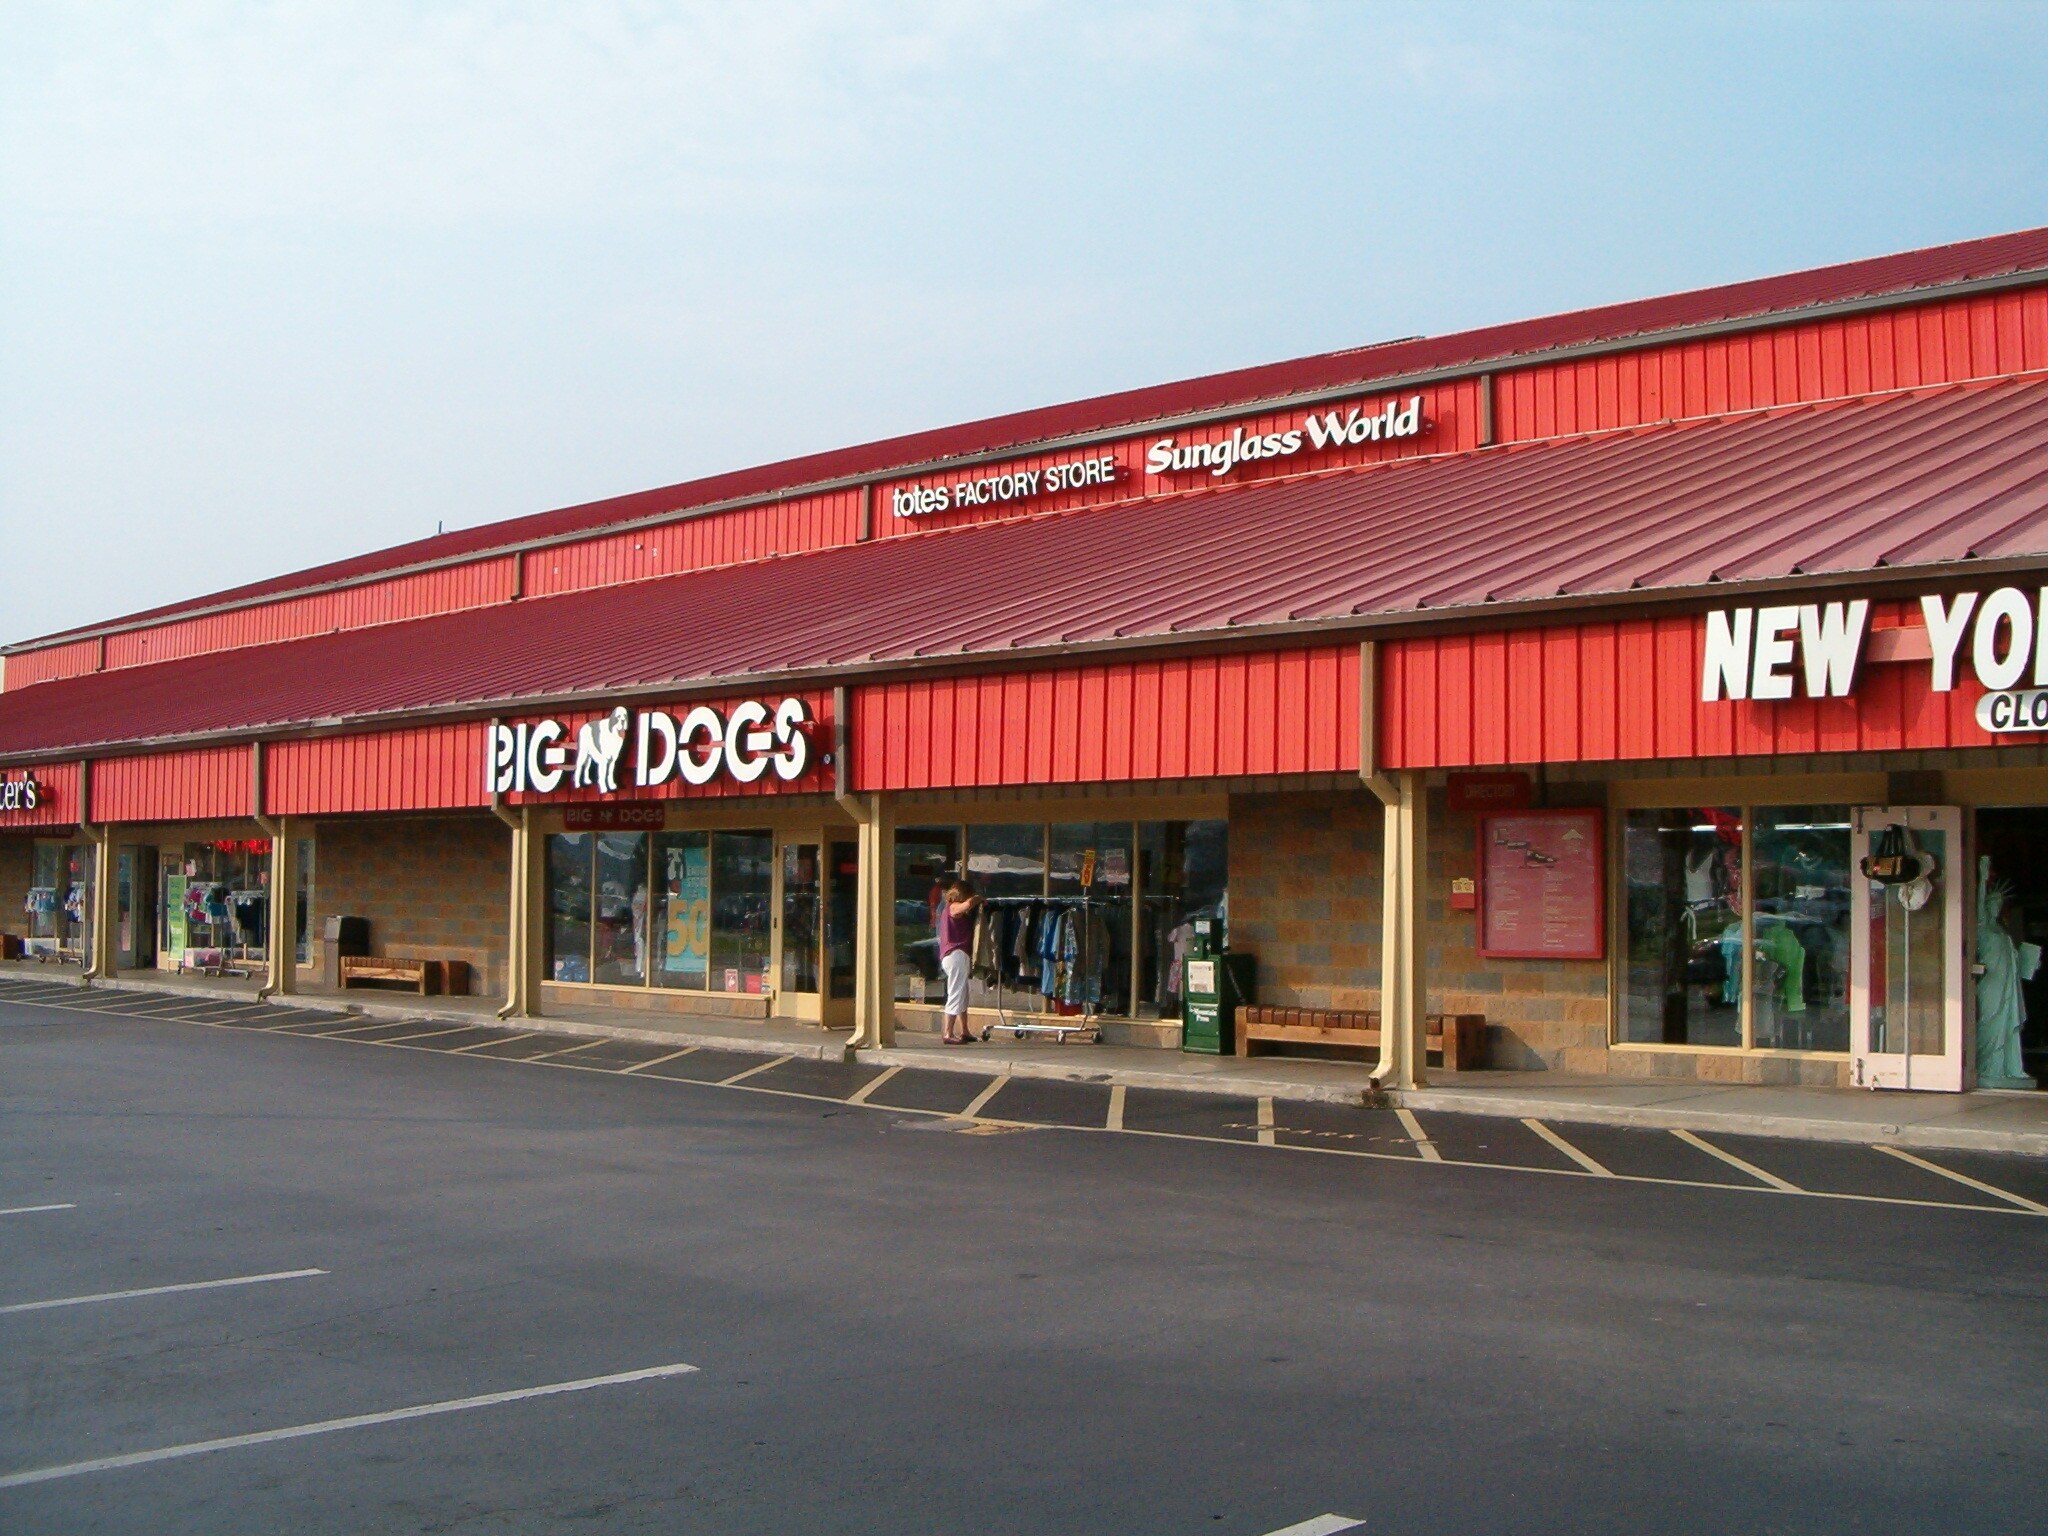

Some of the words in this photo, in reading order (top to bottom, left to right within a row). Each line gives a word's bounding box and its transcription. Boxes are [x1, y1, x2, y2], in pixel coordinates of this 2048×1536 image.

[1146, 427, 1302, 476] Sunglass
[1304, 396, 1421, 450] World
[892, 484, 949, 517] totes
[955, 470, 1041, 507] FACTORY
[1045, 455, 1115, 492] STORE
[1702, 599, 1869, 702] NEW
[487, 718, 566, 793] BIG
[636, 697, 806, 786] DOGS
[566, 808, 592, 822] BIG
[619, 808, 663, 823] DOGS
